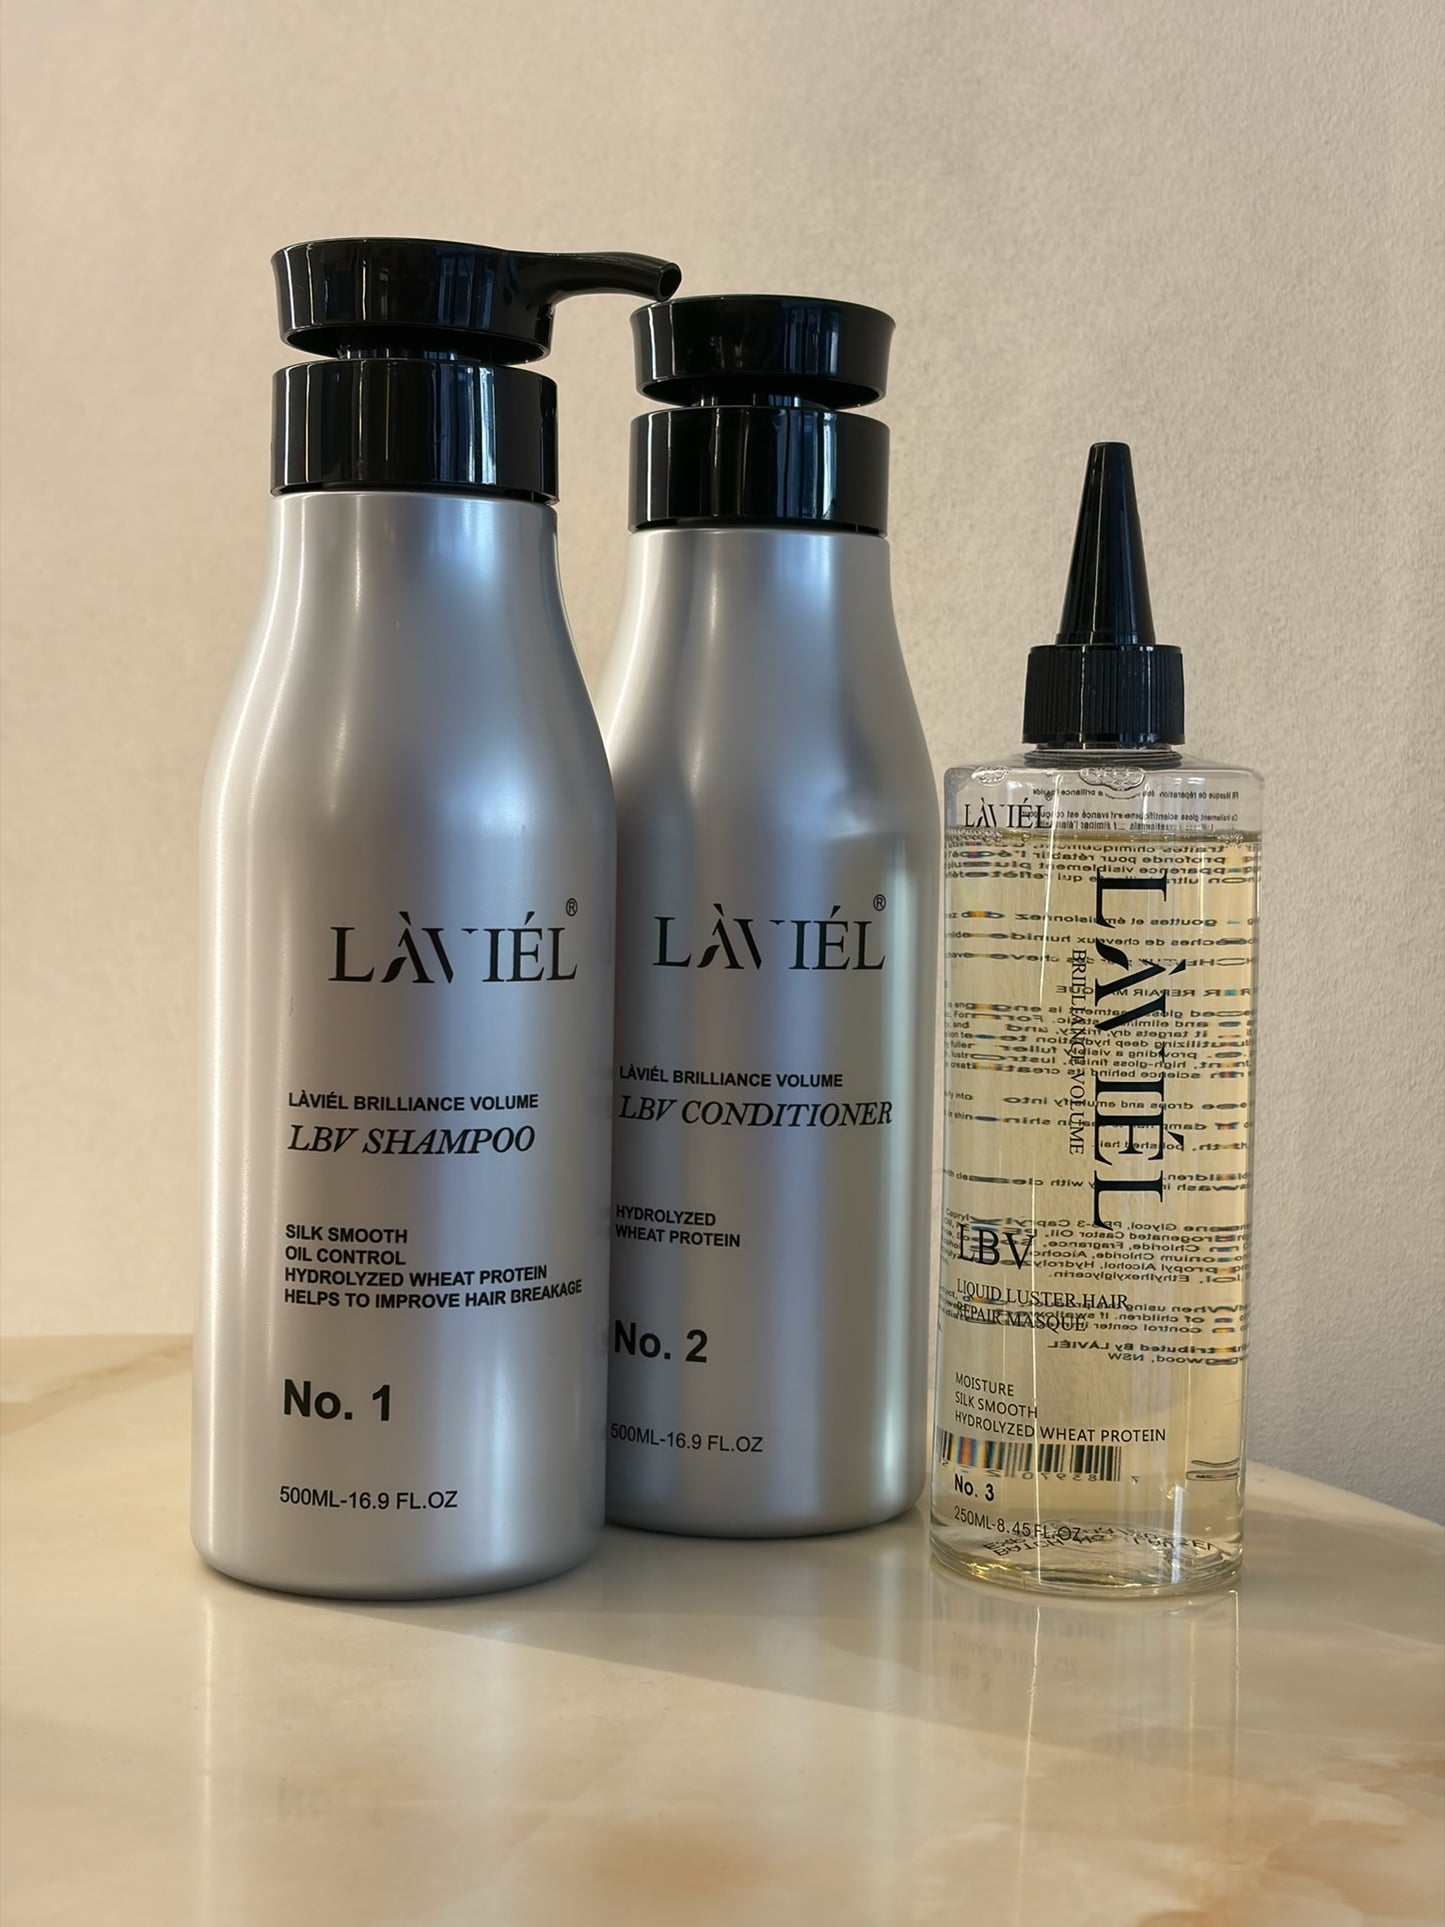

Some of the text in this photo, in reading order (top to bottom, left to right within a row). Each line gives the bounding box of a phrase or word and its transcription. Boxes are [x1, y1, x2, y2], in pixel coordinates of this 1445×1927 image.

[619, 1063, 843, 1088] LÀVIÉL BRILLIANCE VOLUME
[288, 1089, 539, 1112] LÀVIÉL BRILLIANCE VOLUME
[618, 1094, 893, 1127] LBV CONDITIONER
[1070, 1072, 1086, 1155] VOLUME
[287, 1124, 536, 1156] LBV SHAMPOO
[616, 1204, 716, 1227] HYDROLYZED
[285, 1224, 408, 1244] SILK SMOOTH
[615, 1223, 741, 1247] WHEAT PROTEIN
[955, 1223, 1035, 1270] LBV
[285, 1246, 406, 1265] OIL CONTROL
[285, 1265, 547, 1287] HYDROLYZED WHEAT PROTEIN
[284, 1279, 582, 1309] HELPS TO IMPROVE HAIR BREAKAGE
[957, 1278, 1002, 1302] LIQUID
[1006, 1288, 1076, 1308] LUSTER
[1082, 1293, 1130, 1310] HAIR
[957, 1301, 1002, 1326] REPAIR
[1006, 1313, 1087, 1334] MASQUE
[614, 1320, 708, 1363] No. 2
[955, 1372, 1014, 1397] MOISTURE
[283, 1379, 390, 1422] No. 1
[955, 1391, 1038, 1419] SILK SMOOTH
[610, 1423, 763, 1453] 500ML-16.9 FL.OZ
[955, 1410, 1166, 1443] HYDROLYZED WHEAT PROTEIN
[279, 1486, 458, 1510] 500ML-16.9 FL.OZ
[954, 1473, 995, 1501] No. 3
[954, 1505, 1032, 1538] 250ML-8.45
